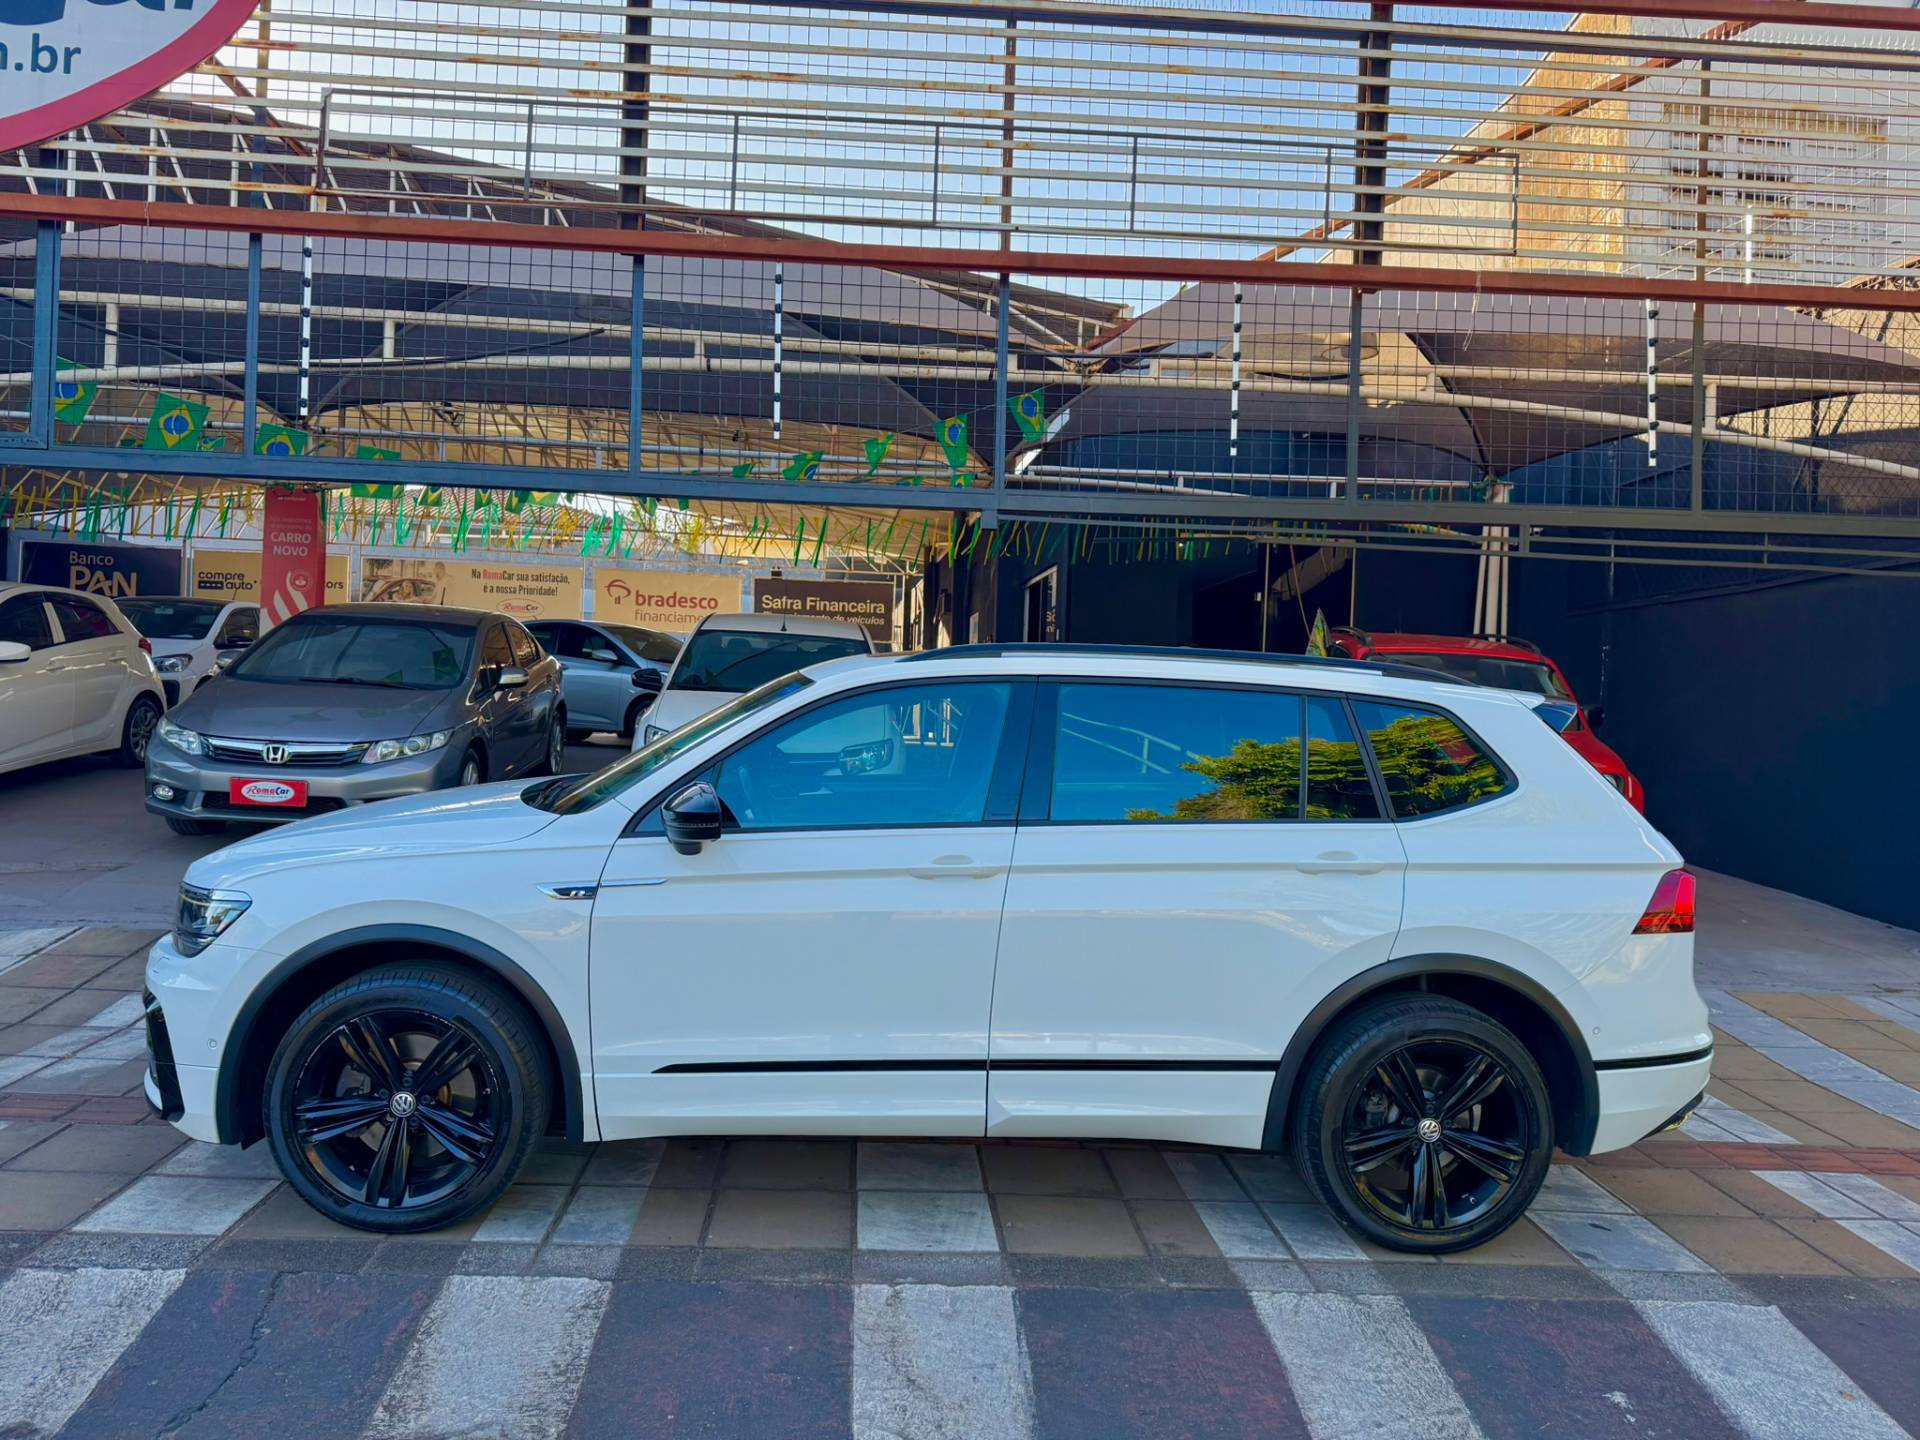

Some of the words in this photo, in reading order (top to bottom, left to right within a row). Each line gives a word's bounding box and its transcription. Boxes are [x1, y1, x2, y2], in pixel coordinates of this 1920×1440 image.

[270, 531, 311, 544] CARRO
[272, 545, 308, 557] NOVO
[69, 550, 114, 566] Banco
[69, 565, 137, 597] PAN
[198, 570, 245, 582] compre
[471, 568, 482, 580] Na
[516, 573, 530, 582] sua
[530, 571, 570, 585] satisfação,
[225, 580, 253, 590] auto
[326, 581, 344, 590] ors
[489, 585, 494, 594] a
[495, 585, 517, 595] nossa
[518, 585, 558, 597] Prioridade!
[635, 590, 718, 610] bradesco
[761, 594, 802, 610] Safra
[806, 596, 885, 614] Financeira
[246, 785, 290, 795] RomaCar
